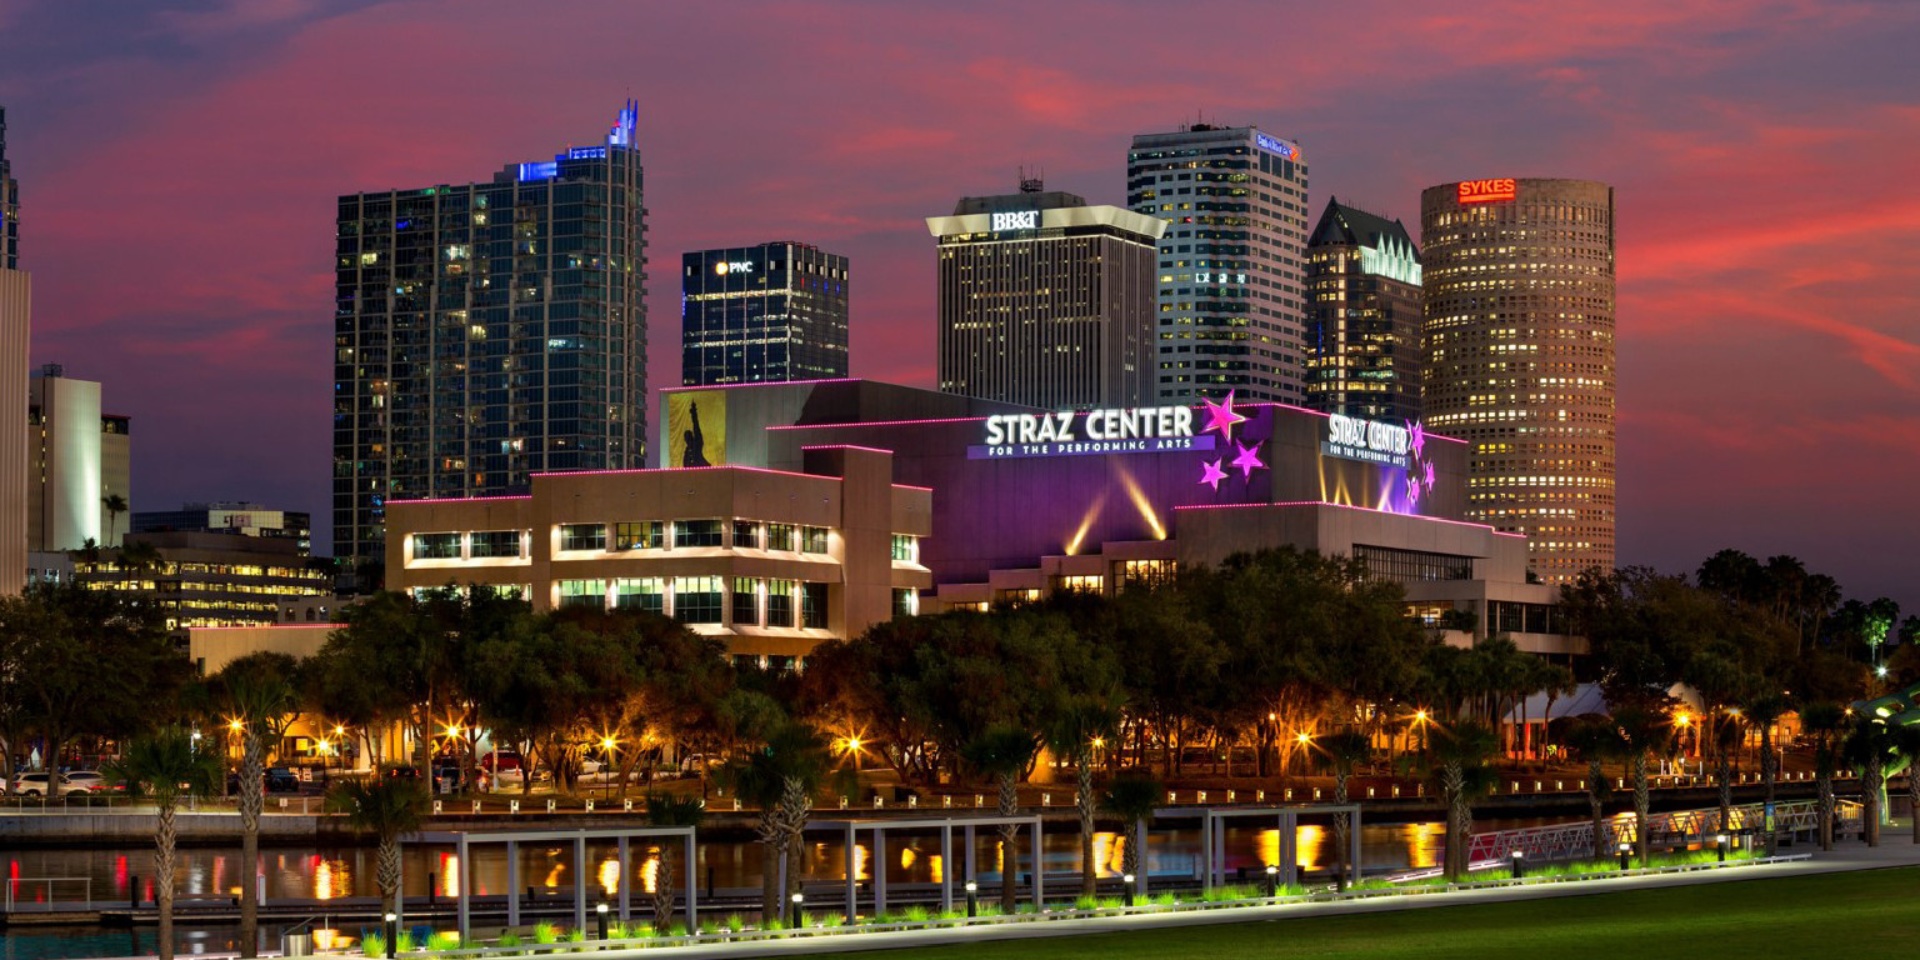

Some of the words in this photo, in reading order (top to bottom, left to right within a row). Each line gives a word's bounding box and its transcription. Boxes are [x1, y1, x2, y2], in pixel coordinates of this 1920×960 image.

[1459, 178, 1515, 195] SYKES
[992, 209, 1039, 231] BB&T
[729, 260, 753, 274] PNC
[985, 412, 1075, 445] STRAZ
[1086, 405, 1193, 440] CENTER
[1329, 413, 1366, 447] STRAZ
[1368, 421, 1406, 454] CENTER
[989, 446, 1013, 456] FOR
[1023, 445, 1048, 455] THE
[1058, 441, 1145, 453] PERFORMING
[1157, 439, 1191, 450] ARTS
